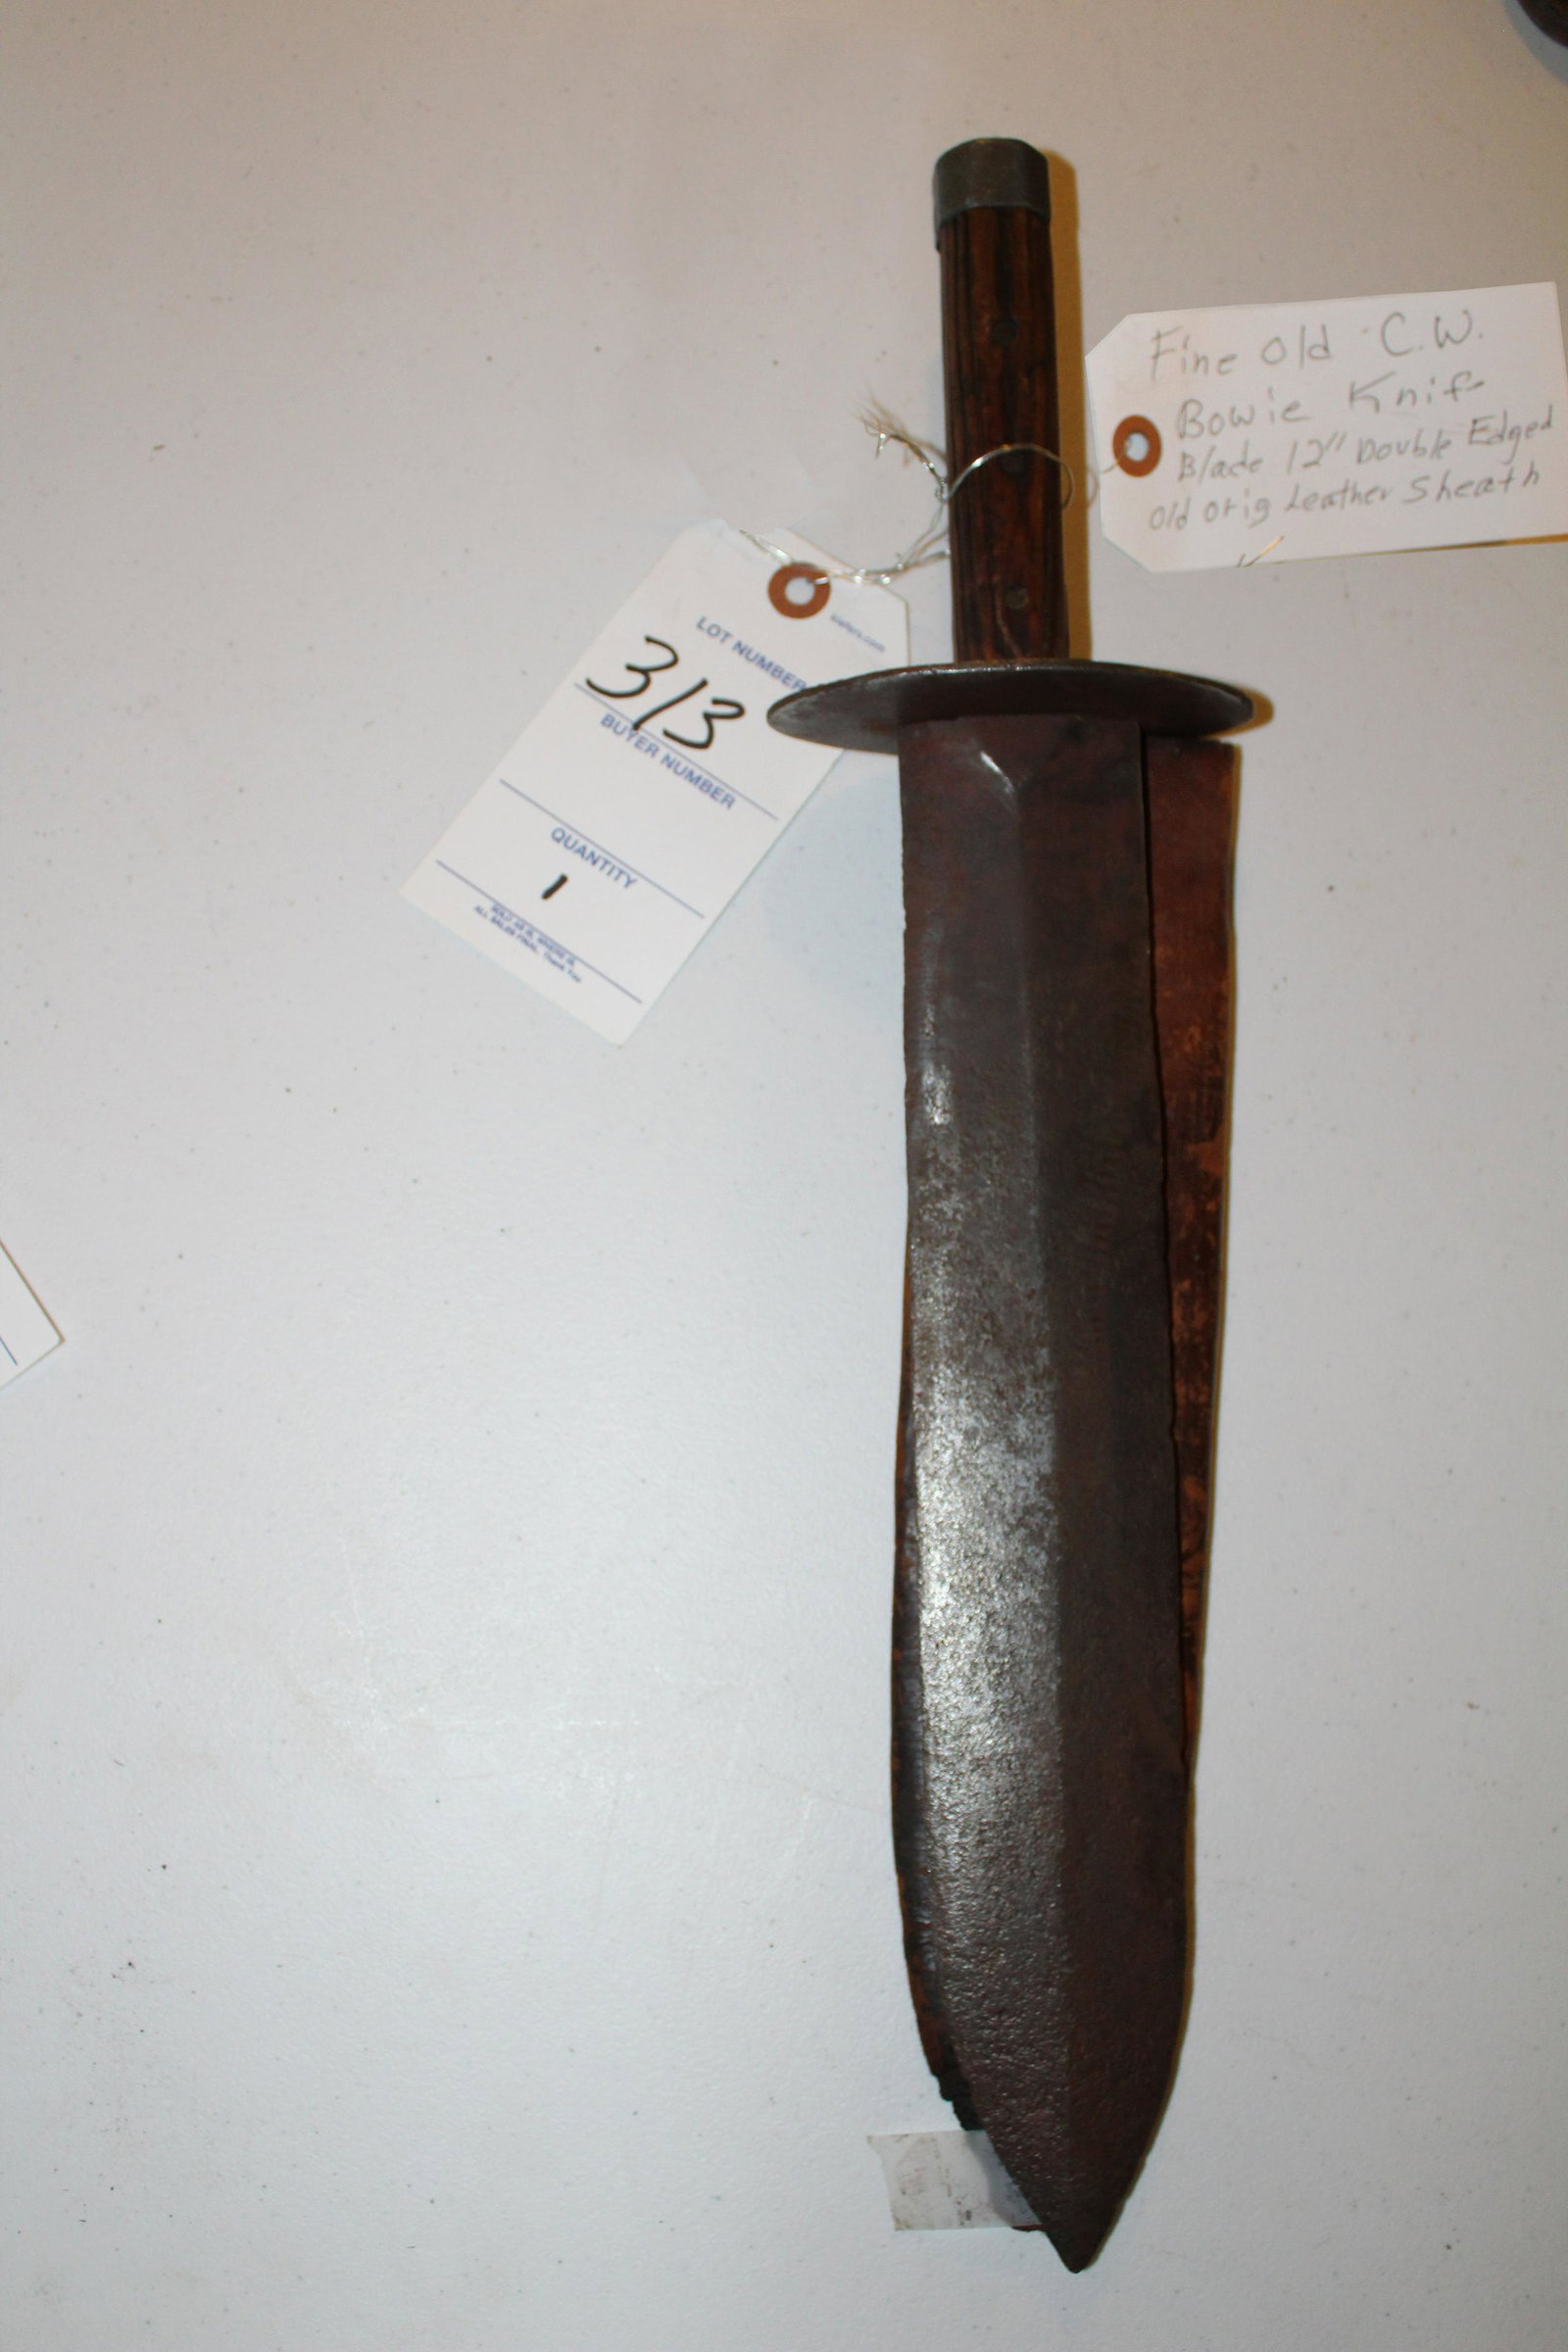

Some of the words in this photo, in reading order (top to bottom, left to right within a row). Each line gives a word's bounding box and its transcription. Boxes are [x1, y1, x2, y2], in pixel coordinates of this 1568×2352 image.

[1151, 326, 1238, 381] Fine
[1260, 324, 1333, 369] Old
[1178, 386, 1312, 439] Bowie
[1178, 439, 1264, 484] Blade
[1469, 404, 1553, 466] Edged
[1285, 478, 1392, 513] Leather
[1401, 460, 1541, 506] Sheath
[695, 614, 734, 645] LOT
[730, 639, 809, 692] NUMBER
[585, 635, 747, 751] 313
[600, 712, 662, 760] BUYER
[661, 752, 737, 810] NUMBER
[549, 826, 639, 890] QUANTITY
